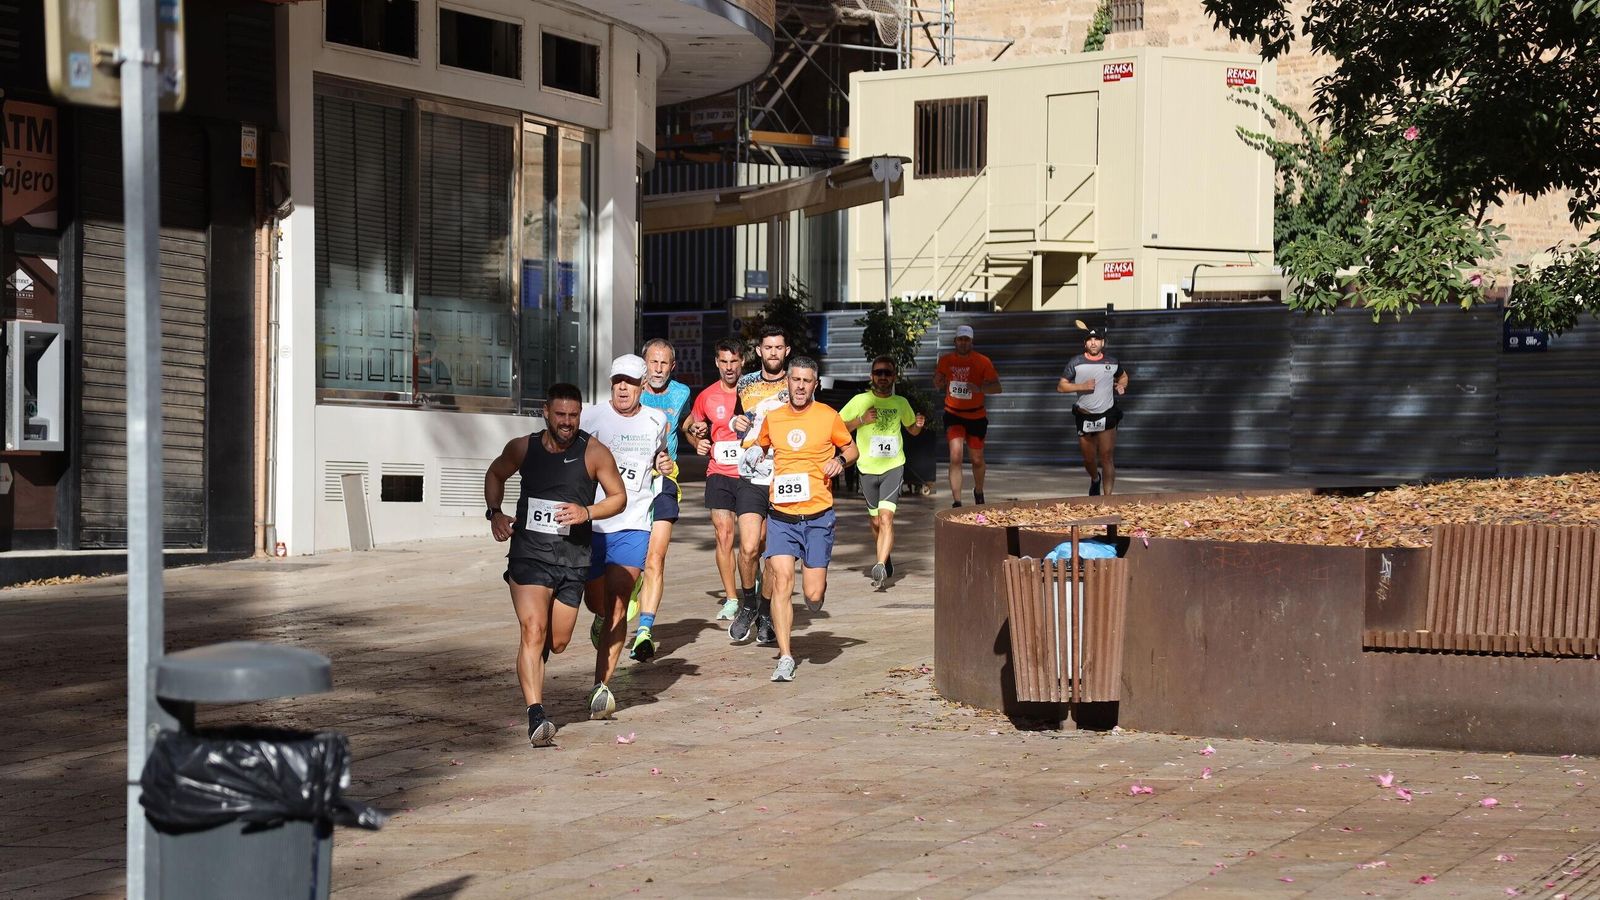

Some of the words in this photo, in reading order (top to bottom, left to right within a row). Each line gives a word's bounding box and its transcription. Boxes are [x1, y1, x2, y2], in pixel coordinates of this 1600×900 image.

[1104, 63, 1132, 74] REMSA
[1227, 68, 1256, 80] REMSA
[1104, 262, 1132, 273] REMSA
[878, 443, 891, 451] 14
[723, 449, 737, 458] 13
[778, 483, 802, 495] 839
[533, 510, 557, 523] 61
